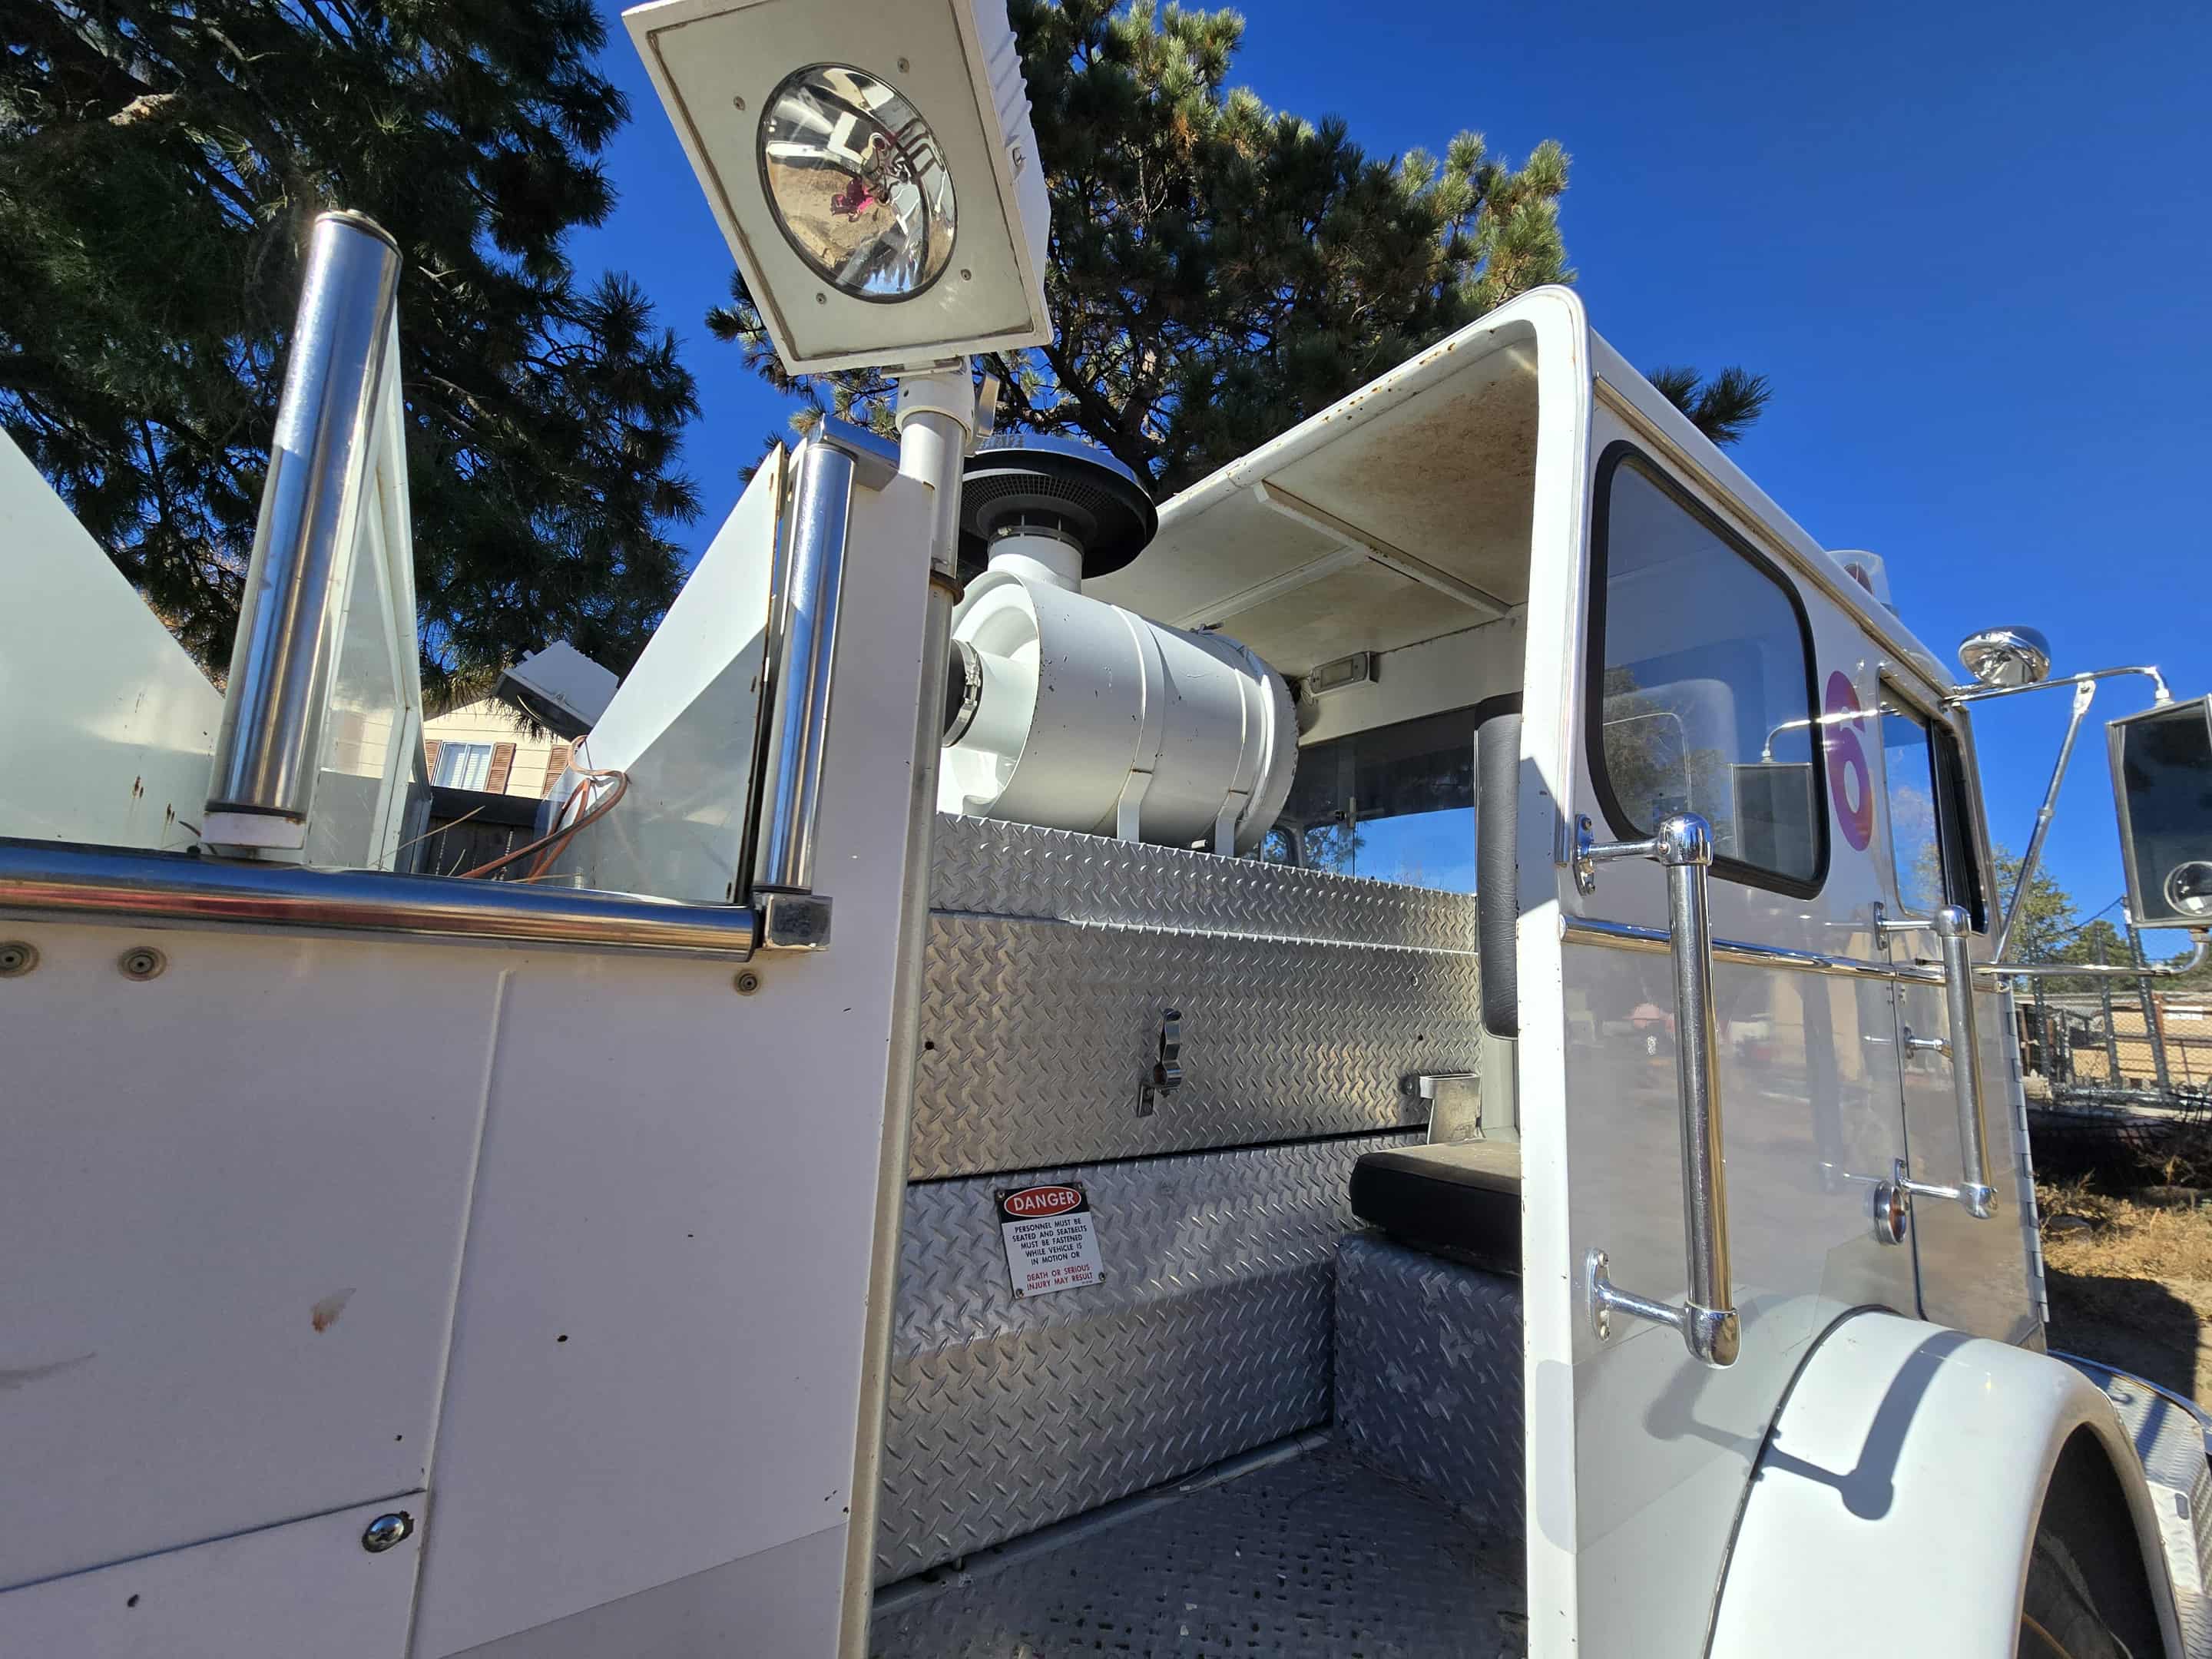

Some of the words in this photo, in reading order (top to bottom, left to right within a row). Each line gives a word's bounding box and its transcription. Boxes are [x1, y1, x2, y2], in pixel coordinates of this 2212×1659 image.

[1825, 671, 1873, 851] 6
[1014, 1191, 1076, 1211] DANGER
[1012, 1233, 1036, 1242] SEATED
[1057, 1225, 1087, 1236] SEATBELTS
[1015, 1223, 1051, 1233] PERSONNEL
[1055, 1219, 1071, 1227] MUST
[1021, 1240, 1038, 1250] MUST
[1052, 1234, 1082, 1244] FASTENED
[1025, 1248, 1045, 1257] WHILE
[1048, 1243, 1074, 1253] VEHICLE
[1031, 1257, 1039, 1266] IN
[1042, 1253, 1068, 1263] MOTION
[1026, 1271, 1048, 1281] DEATH
[1064, 1263, 1090, 1274] SERIOUS
[1026, 1280, 1050, 1291] INJURY
[1055, 1276, 1068, 1285] MAY
[1072, 1272, 1092, 1282] RESULT
